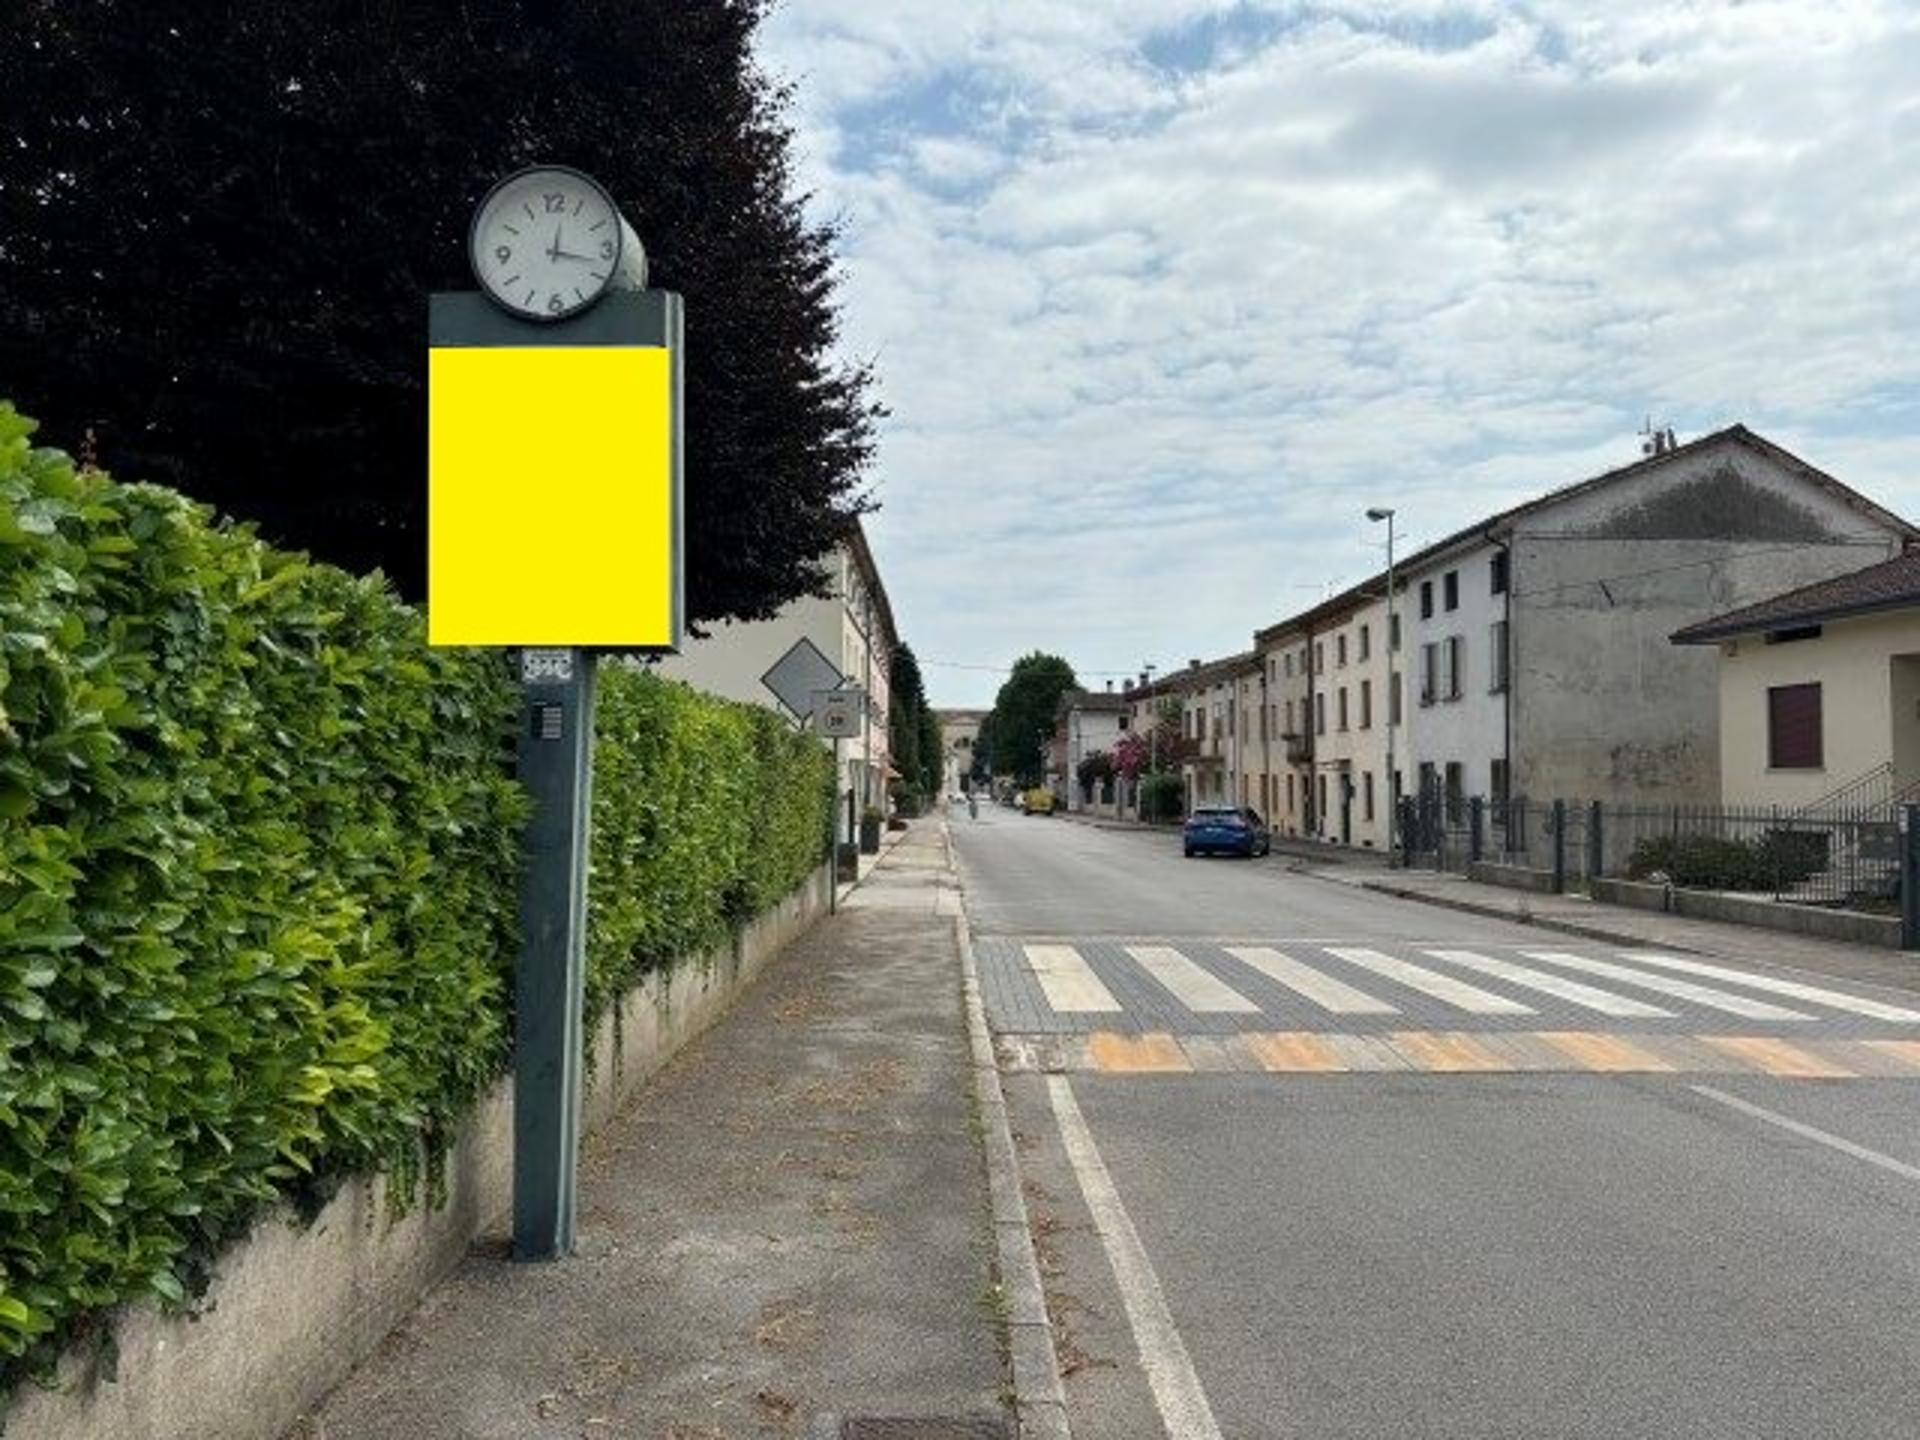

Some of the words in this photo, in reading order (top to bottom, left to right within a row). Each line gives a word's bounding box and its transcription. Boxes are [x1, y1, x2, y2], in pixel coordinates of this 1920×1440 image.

[543, 192, 565, 213] 12
[496, 245, 511, 265] 9
[601, 240, 613, 261] 3
[548, 293, 564, 312] 6
